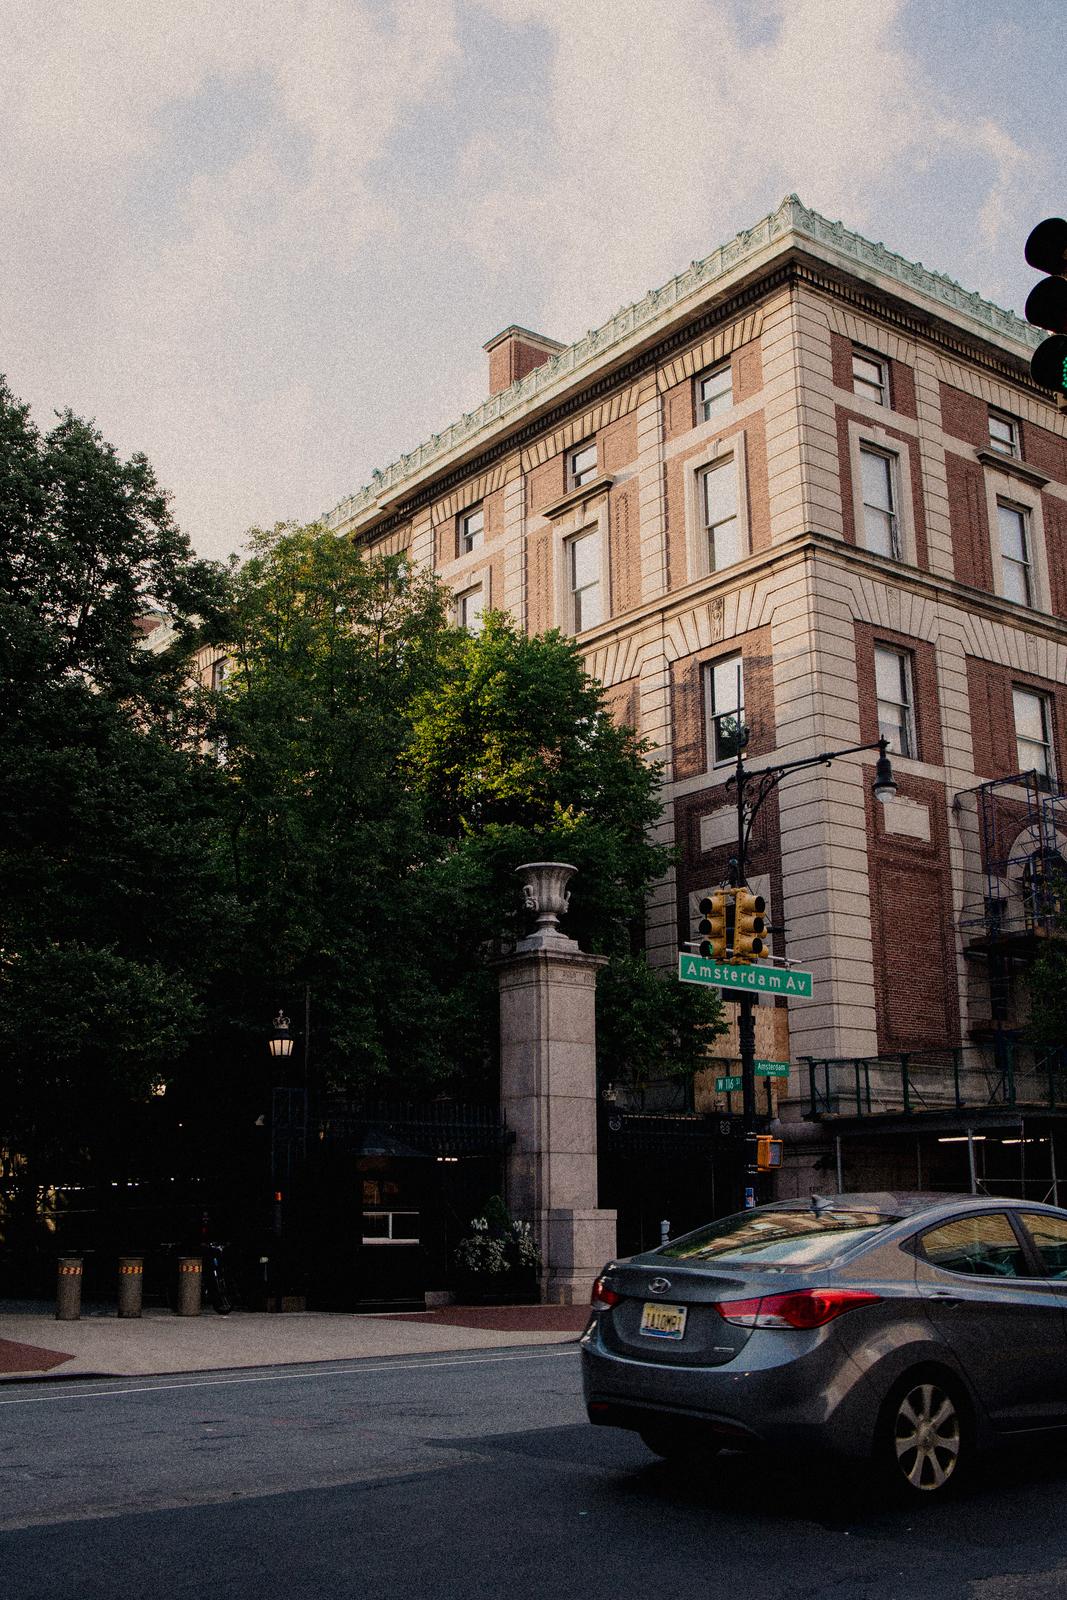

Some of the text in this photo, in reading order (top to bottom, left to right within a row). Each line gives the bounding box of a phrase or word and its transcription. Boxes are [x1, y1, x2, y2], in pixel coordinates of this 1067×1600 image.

[687, 961, 805, 991] Amsterdam Av
[757, 1062, 785, 1071] Amsterdam
[717, 1079, 723, 1090] W
[725, 1078, 734, 1090] 116
